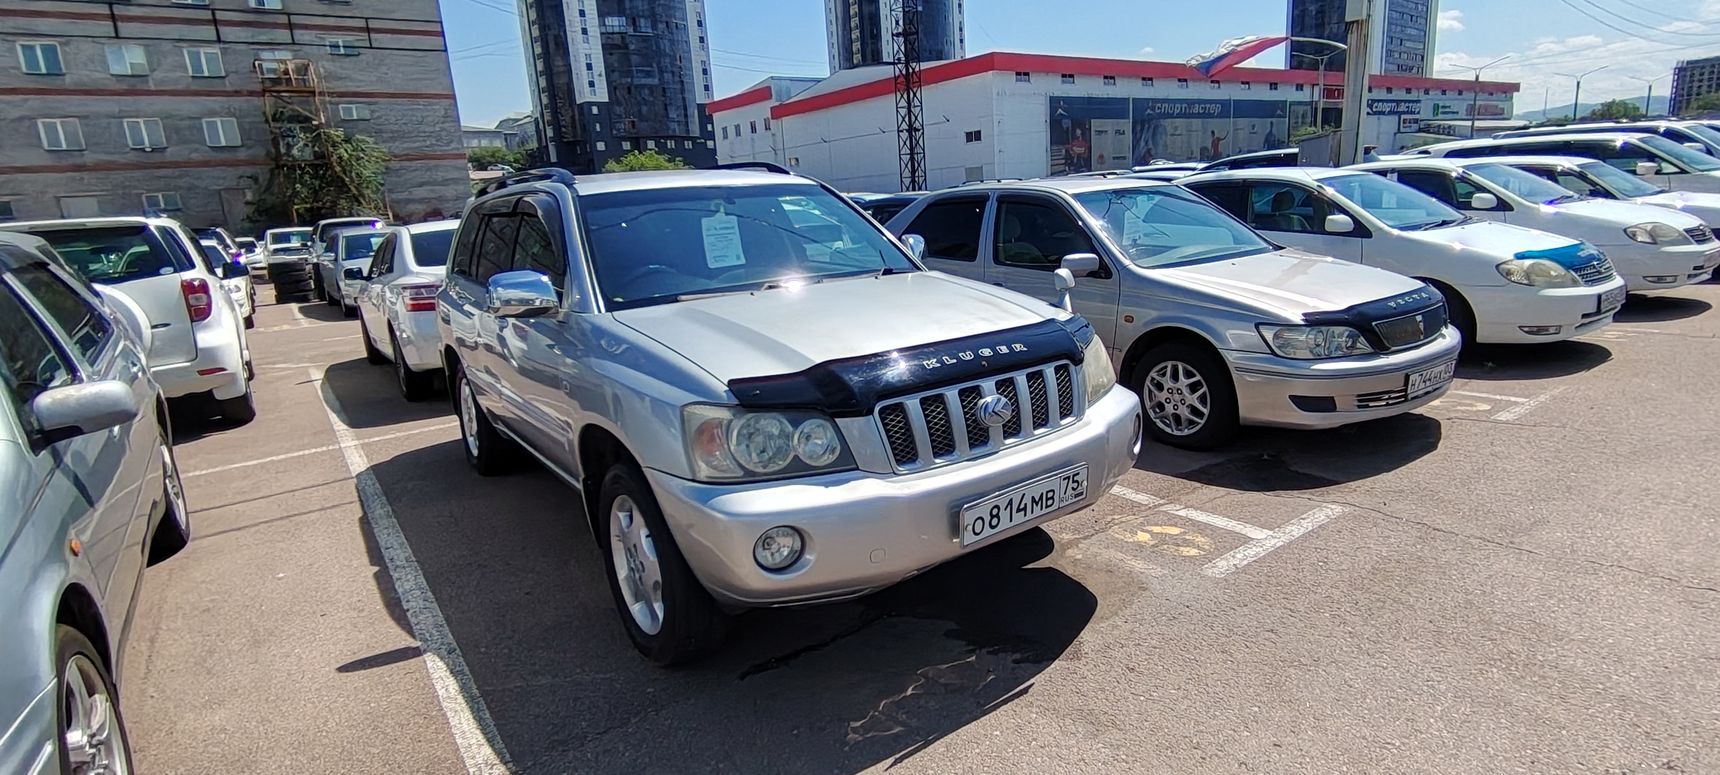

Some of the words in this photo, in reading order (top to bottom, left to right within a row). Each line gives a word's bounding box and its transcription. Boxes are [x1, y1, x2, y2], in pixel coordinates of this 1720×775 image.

[923, 343, 1028, 369] KLUGER
[1062, 472, 1080, 495] 75
[1061, 494, 1074, 503] RUS
